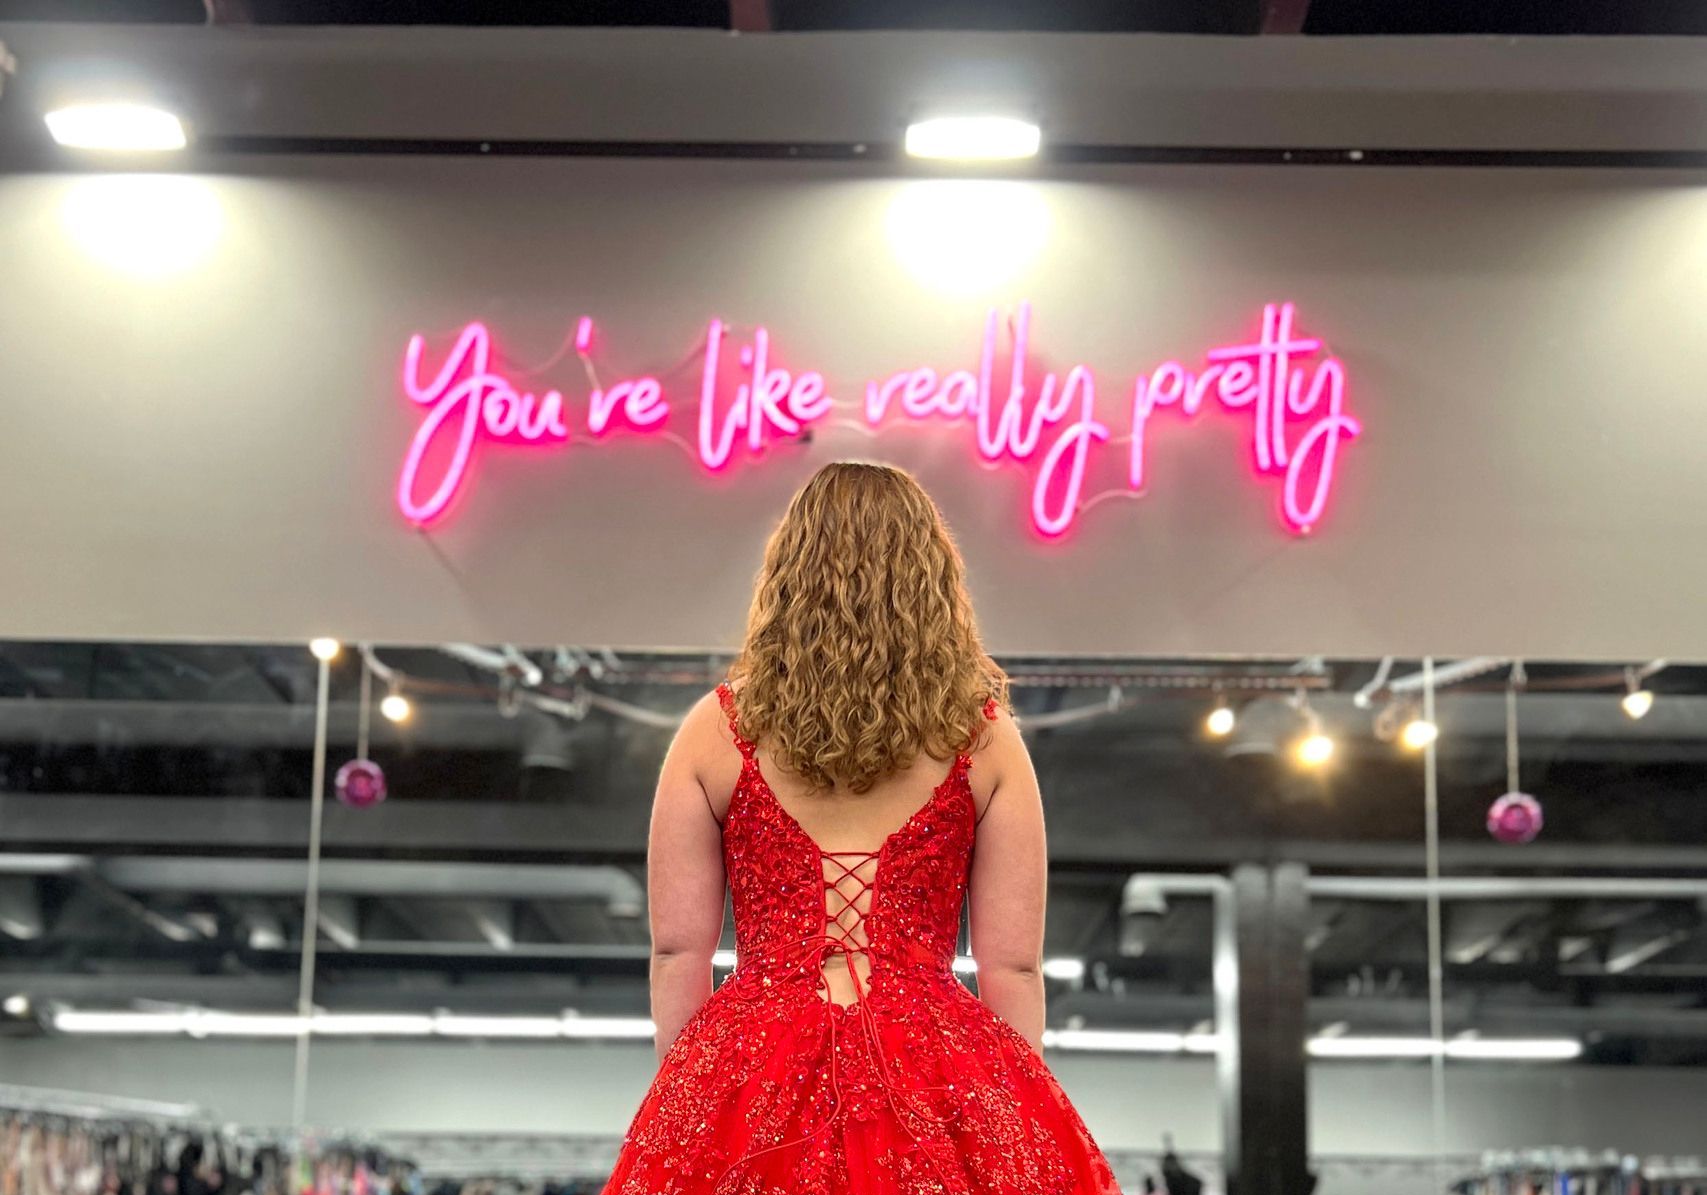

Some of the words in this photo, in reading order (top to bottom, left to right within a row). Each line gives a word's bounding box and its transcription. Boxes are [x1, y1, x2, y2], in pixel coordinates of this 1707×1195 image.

[399, 316, 670, 522] You're
[700, 319, 832, 468] like
[866, 301, 1109, 534] really
[1129, 302, 1361, 527] pretty
